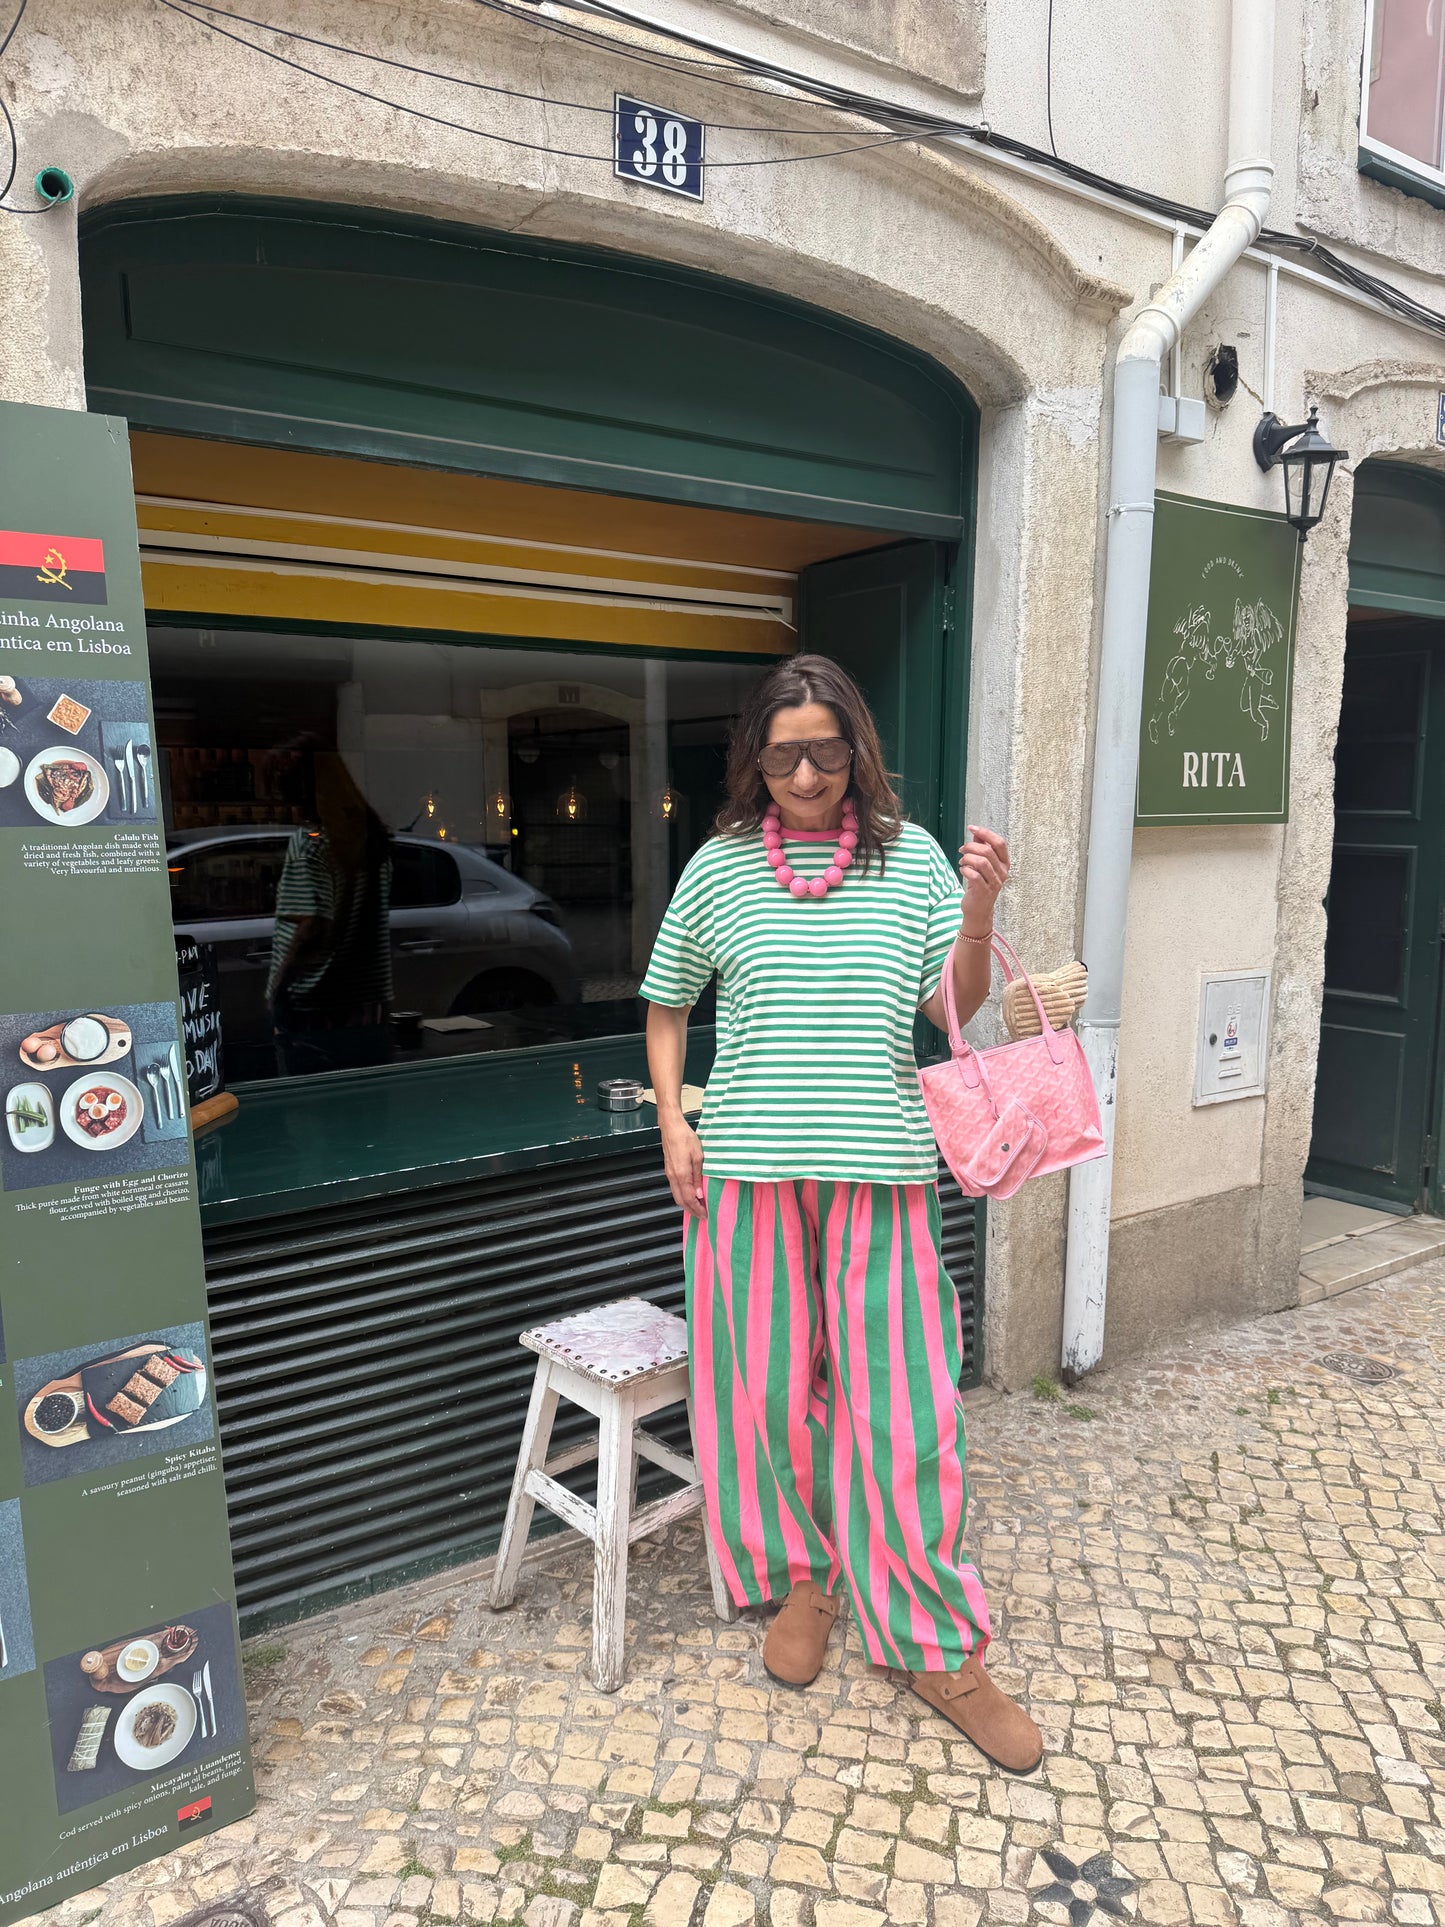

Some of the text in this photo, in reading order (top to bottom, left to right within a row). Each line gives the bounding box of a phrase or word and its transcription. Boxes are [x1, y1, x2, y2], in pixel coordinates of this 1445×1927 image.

[633, 110, 687, 186] 38
[0, 611, 125, 634] inha Angolana
[47, 641, 73, 652] em
[77, 638, 132, 655] Lisboa
[1182, 751, 1246, 787] RITA
[29, 843, 70, 851] traditional
[72, 843, 103, 852] Angolan
[104, 842, 120, 850] dish
[143, 841, 160, 849] with
[114, 833, 159, 841] Calulu Fish
[23, 851, 44, 859] dried
[46, 851, 60, 859] and
[62, 850, 81, 858] fresh
[100, 850, 137, 858] combined
[23, 860, 50, 868] variety
[51, 859, 60, 867] of
[62, 858, 100, 868] vegetables
[116, 857, 134, 866] leafy
[135, 858, 161, 866] greens.
[50, 865, 162, 876] Very flavourful and nutritious.
[180, 982, 210, 1018] IVE
[74, 1171, 188, 1194] Funge with Egg and Chorizo
[14, 1202, 37, 1212] Thick
[60, 1195, 81, 1205] made
[81, 1193, 100, 1201] from
[101, 1189, 120, 1198] white
[121, 1183, 154, 1195] cornmeal
[164, 1180, 189, 1188] cassava
[49, 1206, 69, 1215] flour,
[70, 1201, 93, 1212] served
[95, 1198, 111, 1207] with
[112, 1195, 134, 1205] boiled
[148, 1191, 161, 1199] and
[60, 1195, 190, 1221] accompanied by vegetables and beans.
[165, 1445, 216, 1464] Spicy Kitaba
[81, 1489, 88, 1497] A
[89, 1480, 119, 1495] savoury
[120, 1473, 146, 1488] peanut
[147, 1463, 182, 1480] (ginguba)
[116, 1463, 218, 1497] seasoned with salt and chilli.
[150, 1750, 241, 1793] Macayabo à Luandense
[189, 1766, 243, 1794] kale, and funge.
[59, 1757, 242, 1840] Cod served with spicy onions, palm oil beans, fried
[56, 1852, 109, 1881] autêntica
[111, 1841, 130, 1856] em
[132, 1824, 169, 1848] Lisboa
